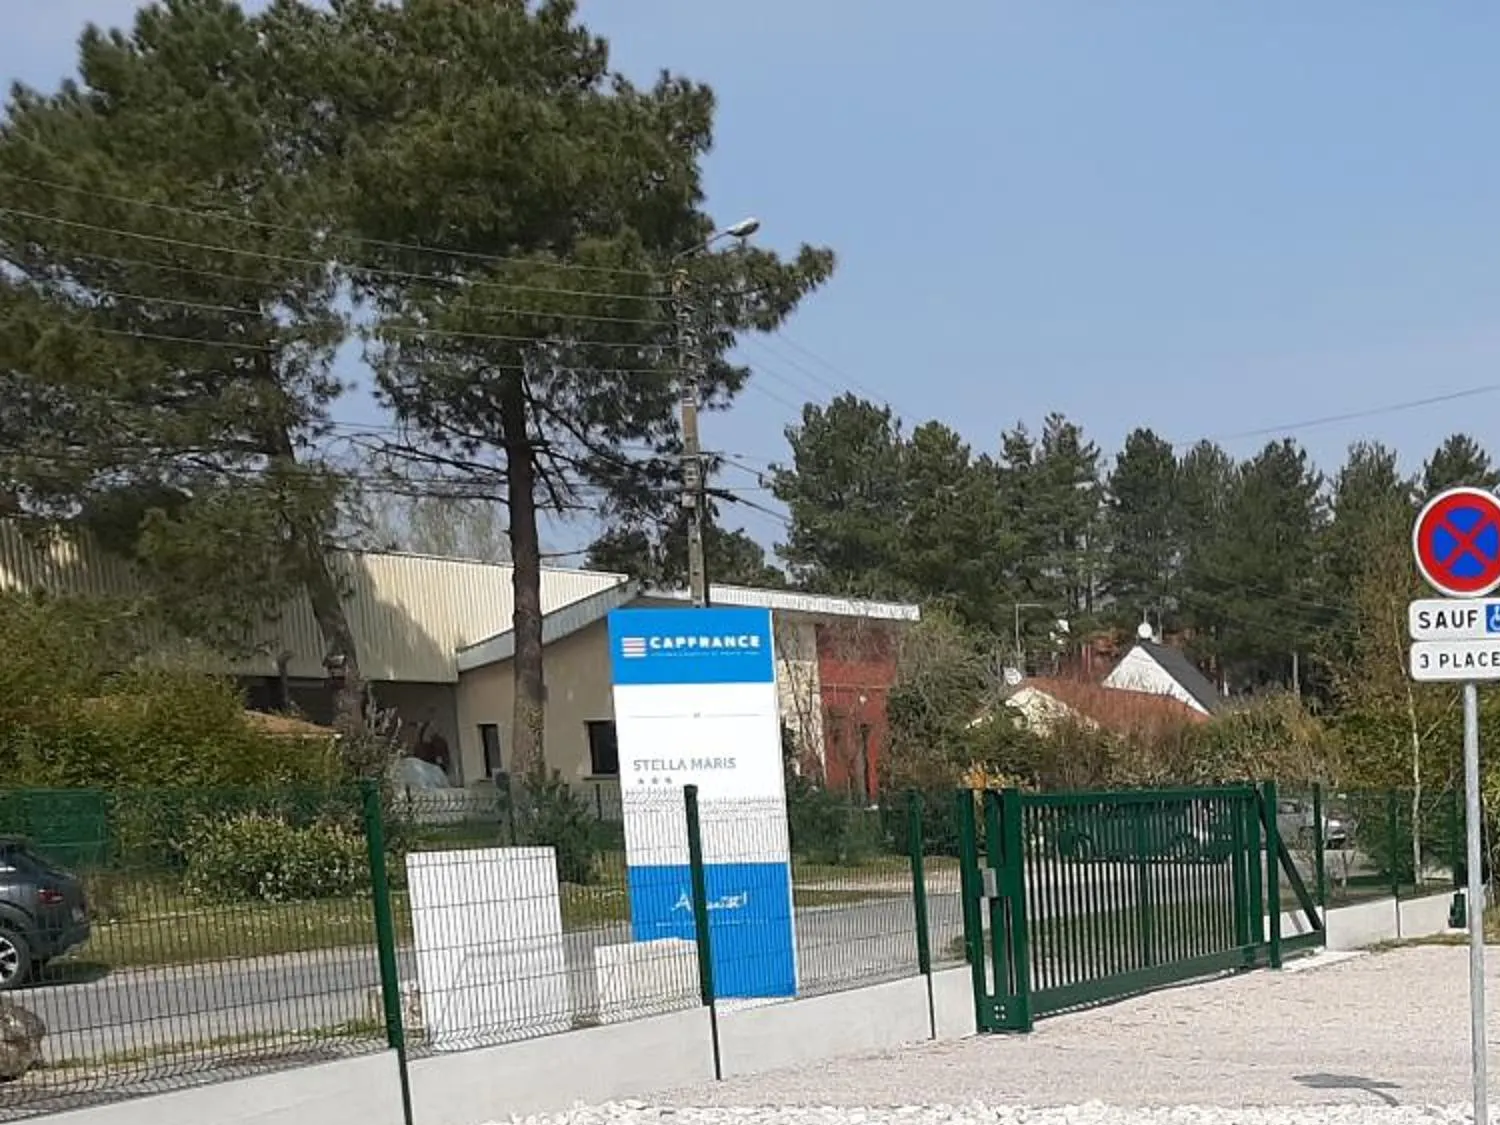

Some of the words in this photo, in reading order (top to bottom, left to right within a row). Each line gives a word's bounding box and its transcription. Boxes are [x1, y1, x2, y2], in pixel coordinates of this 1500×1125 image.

[1418, 609, 1478, 629] SAUF
[649, 635, 761, 649] CAPFRANCE
[1419, 653, 1429, 669] 3
[633, 759, 687, 771] STELLA
[691, 757, 737, 770] MARIS
